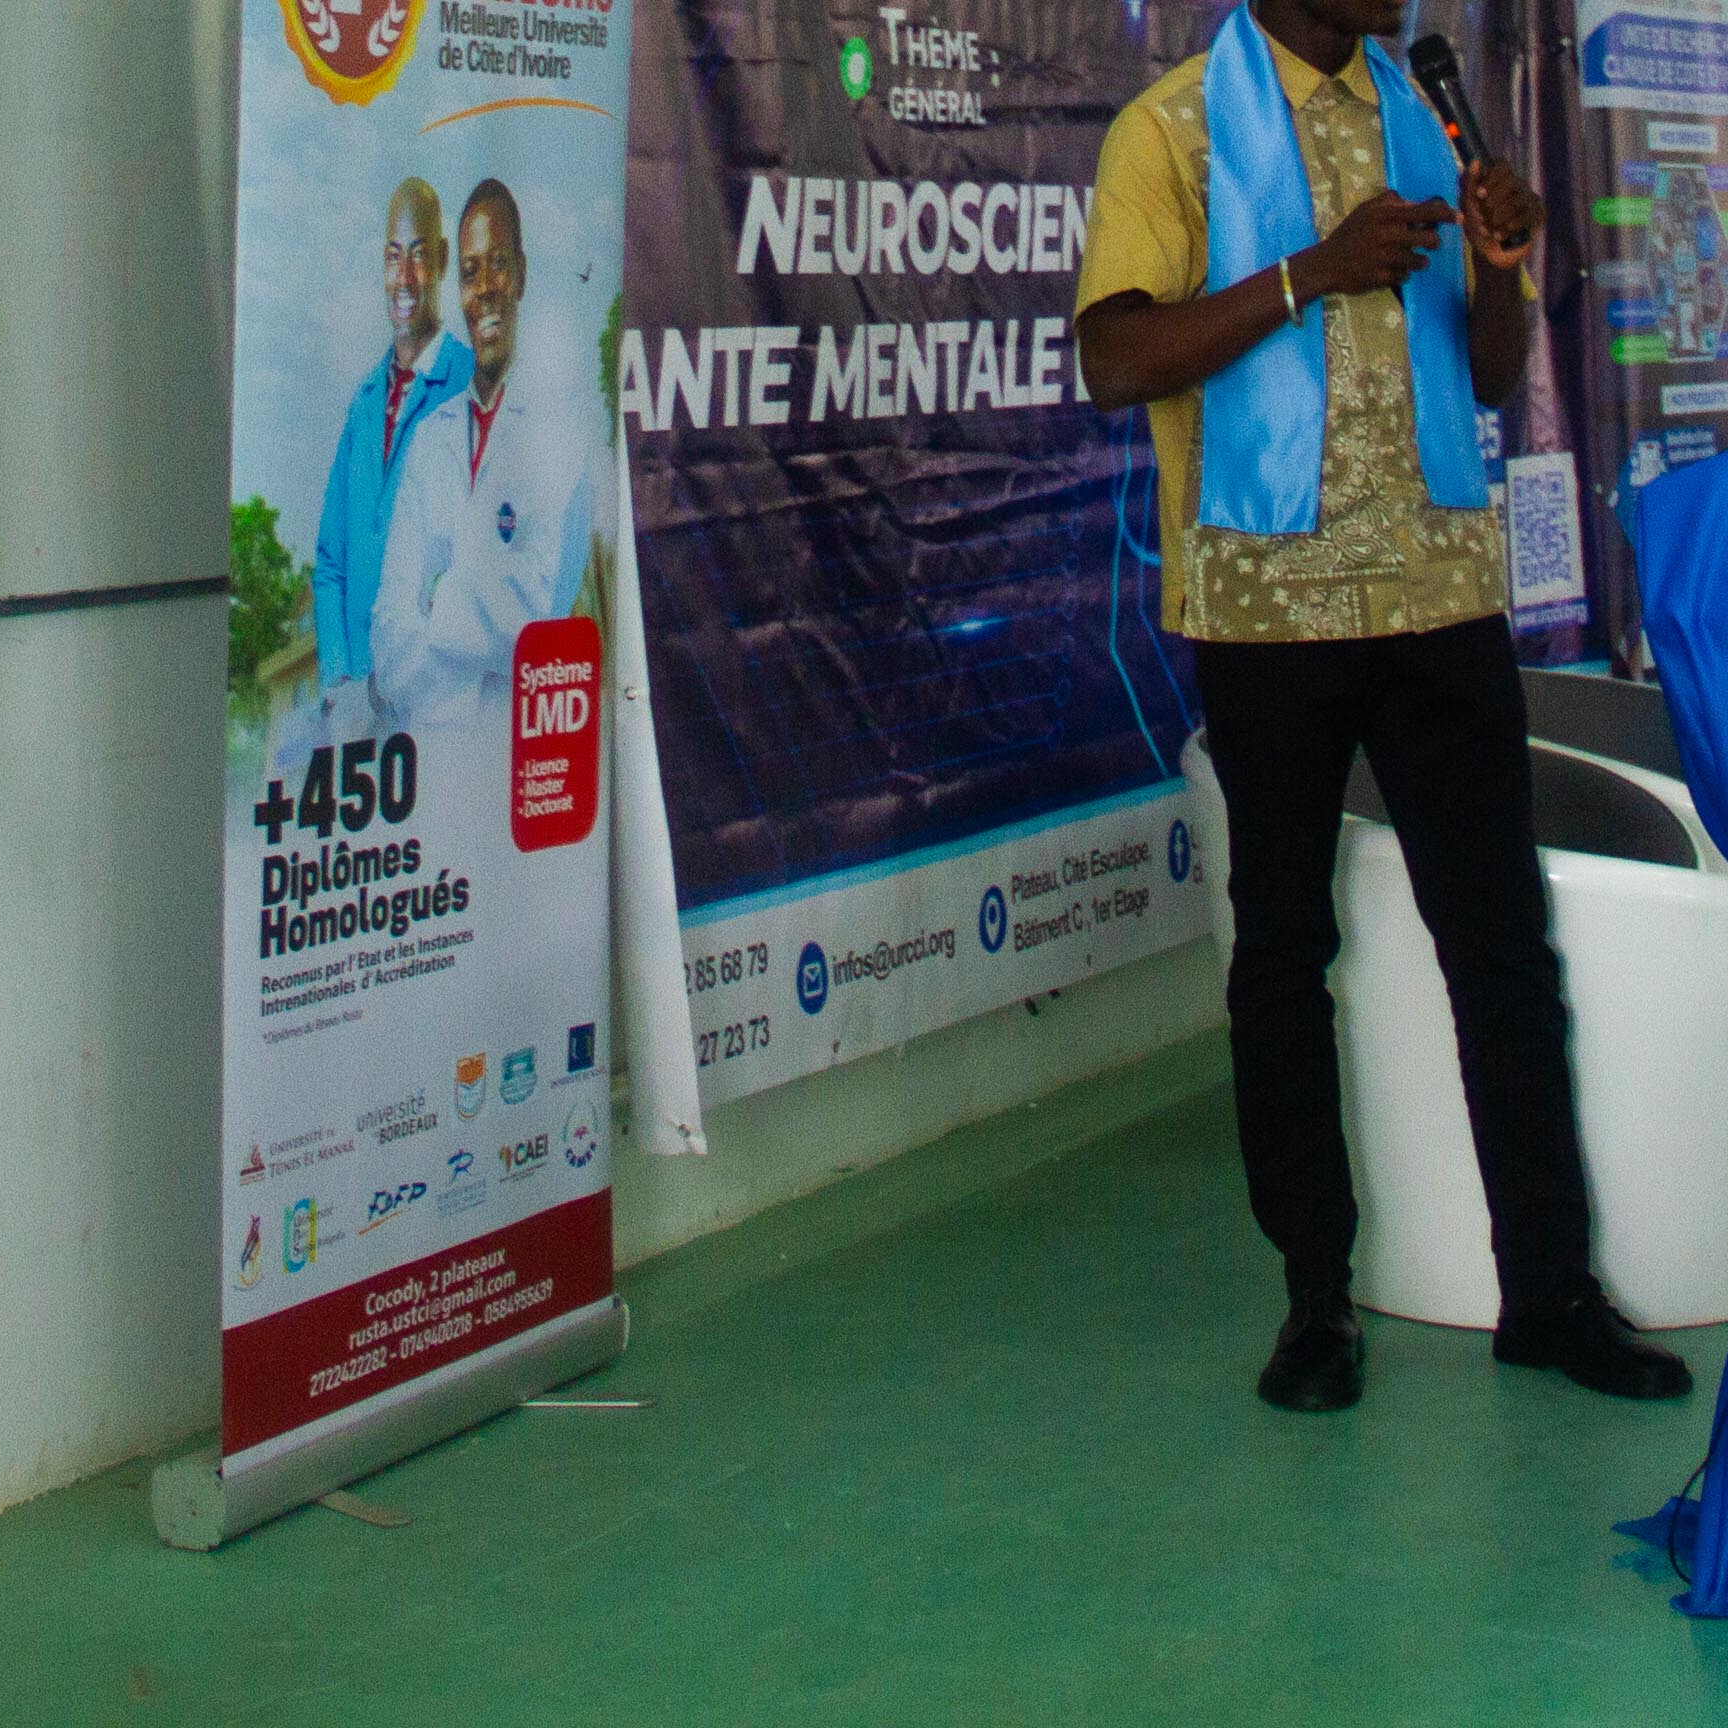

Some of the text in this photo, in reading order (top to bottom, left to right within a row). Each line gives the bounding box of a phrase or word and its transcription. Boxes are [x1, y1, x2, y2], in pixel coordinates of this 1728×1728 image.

[440, 0, 609, 49] Meilleure Université
[439, 37, 464, 71] de
[467, 38, 505, 74] Côte
[810, 317, 1065, 423] MENTALE
[518, 658, 593, 695] Système
[520, 688, 590, 740] LMD
[253, 731, 418, 846] +450
[262, 837, 422, 910] Diplômes
[1062, 852, 1089, 886] Cité
[260, 868, 470, 960] Homologués
[1092, 895, 1113, 924] 1er
[1114, 885, 1151, 919] Etage
[261, 965, 323, 995] Reconnus
[325, 958, 347, 982] par
[384, 946, 397, 966] et
[398, 940, 416, 961] les
[418, 928, 475, 955] Instances
[695, 941, 769, 993] 85 68 79
[833, 928, 955, 987] infos@urcci.org
[698, 1014, 770, 1067] 27 23 73
[379, 1111, 439, 1146] BORDEAUX
[513, 1132, 550, 1167] CAEI
[364, 1248, 506, 1316] Cocody, 2 plateaux
[349, 1269, 517, 1351] rusta.ustci@gmail.com
